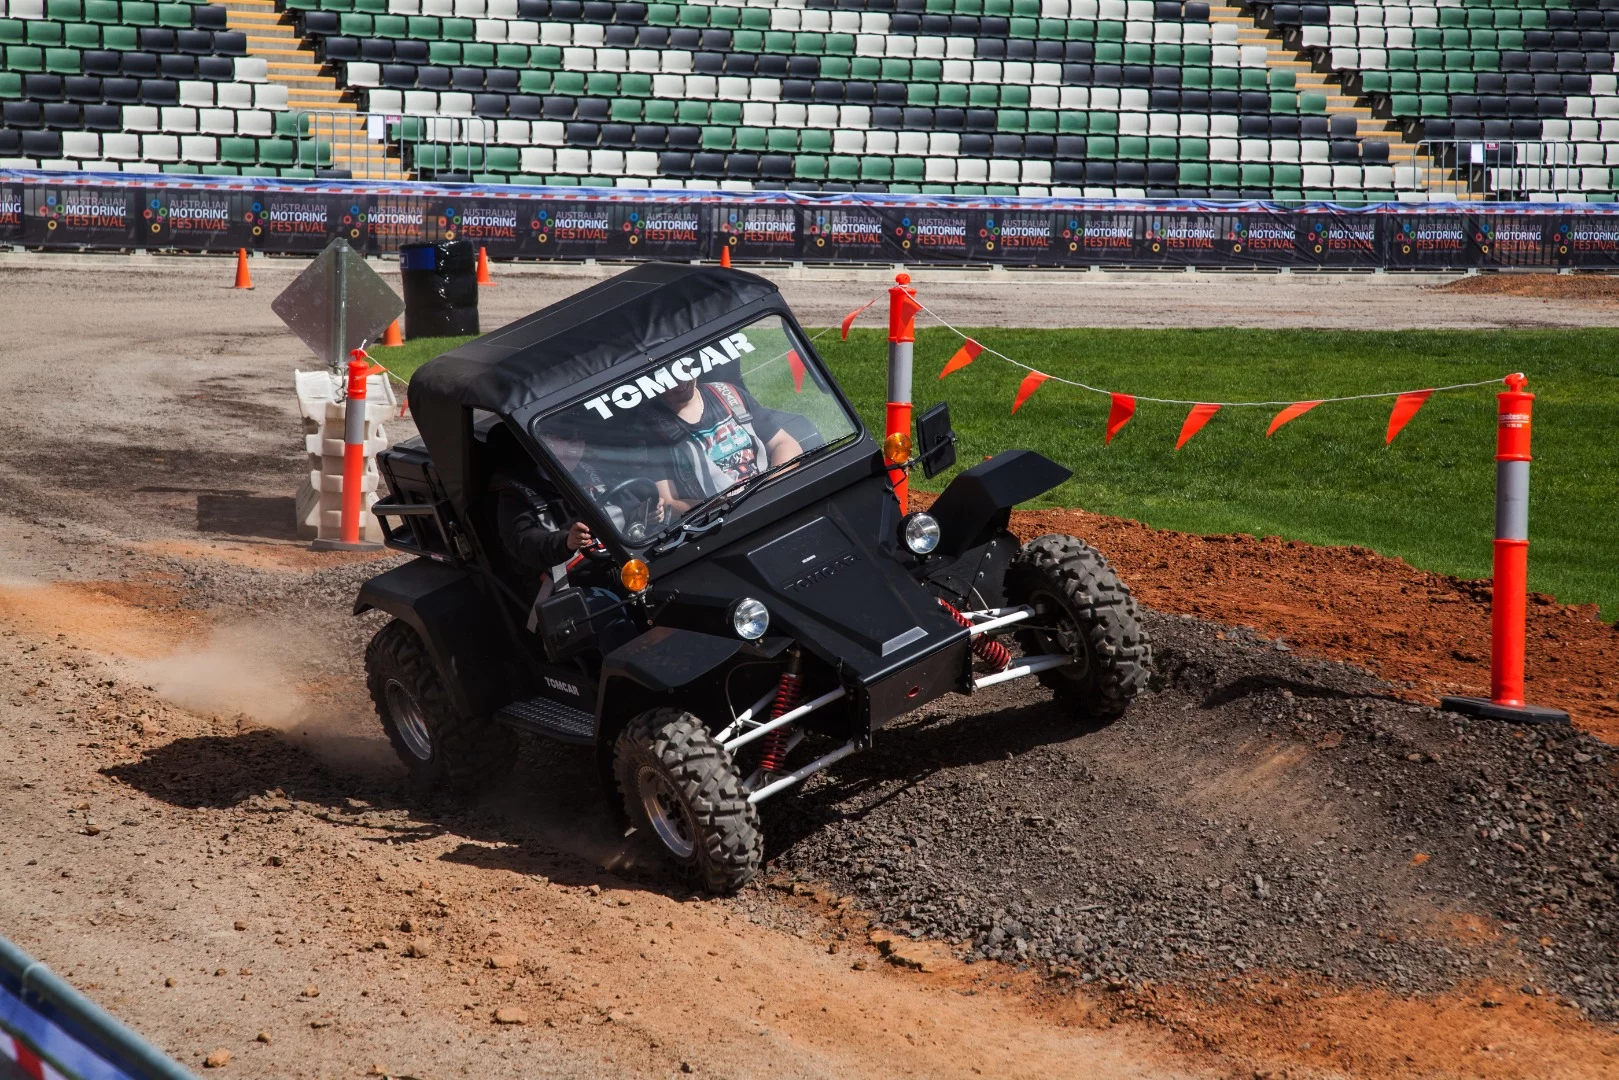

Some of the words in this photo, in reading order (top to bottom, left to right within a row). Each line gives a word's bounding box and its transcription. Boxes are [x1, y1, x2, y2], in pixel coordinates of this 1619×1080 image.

[66, 196, 126, 206] AUSTRALIAN
[170, 200, 228, 209] AUSTRALIAN
[66, 204, 126, 216] MOTORING
[170, 208, 228, 218] MOTORING
[271, 204, 327, 212] AUSTRALIAN
[368, 206, 422, 214] AUSTRALIAN
[463, 208, 516, 218] AUSTRALIAN
[270, 212, 327, 222] MOTORING
[368, 213, 422, 224] MOTORING
[556, 211, 608, 220] AUSTRALIAN
[746, 214, 795, 222] AUSTRALIAN
[66, 215, 126, 227] FESTIVAL
[170, 218, 228, 230] FESTIVAL
[462, 216, 516, 226] MOTORING
[555, 219, 608, 229] MOTORING
[646, 220, 698, 230] MOTORING
[745, 221, 795, 231] MOTORING
[270, 222, 326, 232] FESTIVAL
[368, 224, 421, 235] FESTIVAL
[462, 226, 516, 237] FESTIVAL
[832, 224, 881, 234] MOTORING
[918, 226, 965, 235] MOTORING
[1001, 227, 1050, 237] MOTORING
[555, 229, 607, 240] FESTIVAL
[645, 230, 696, 241] FESTIVAL
[744, 231, 794, 242] FESTIVAL
[1084, 228, 1132, 237] MOTORING
[1167, 229, 1214, 239] MOTORING
[1249, 230, 1295, 240] MOTORING
[1417, 231, 1462, 239] MOTORING
[1496, 232, 1541, 240] MOTORING
[1574, 232, 1619, 240] MOTORING
[832, 234, 881, 243] FESTIVAL
[918, 235, 965, 245] FESTIVAL
[1001, 236, 1048, 246] FESTIVAL
[1084, 237, 1132, 247] FESTIVAL
[1166, 239, 1213, 248] FESTIVAL
[1248, 239, 1294, 249] FESTIVAL
[1417, 240, 1461, 249] FESTIVAL
[1495, 240, 1540, 250] FESTIVAL
[1574, 240, 1618, 250] FESTIVAL
[583, 332, 756, 420] TOMCAR
[544, 676, 580, 696] TOMCAR
